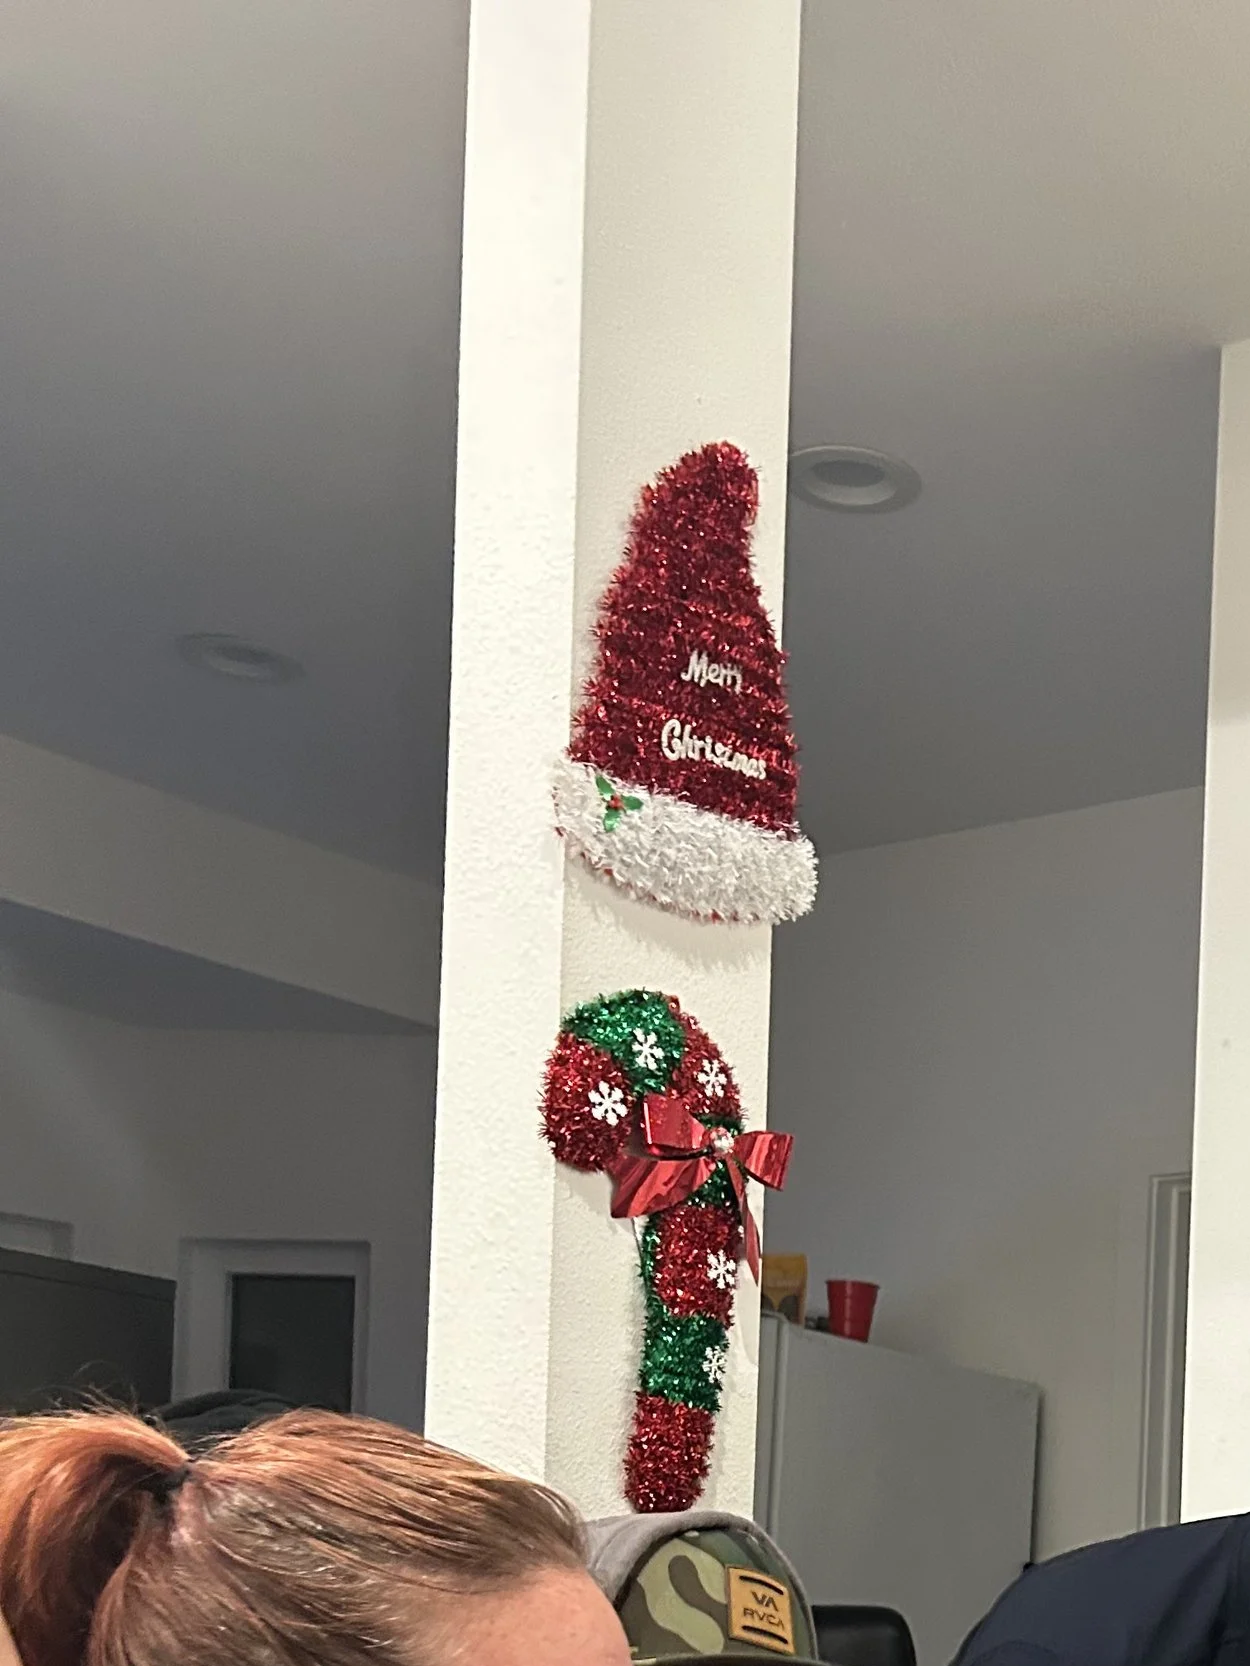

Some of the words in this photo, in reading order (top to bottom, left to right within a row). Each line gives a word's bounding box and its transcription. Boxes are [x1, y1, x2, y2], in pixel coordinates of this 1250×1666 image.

[680, 649, 743, 694] Merry
[661, 718, 767, 780] Christmas
[743, 1607, 785, 1630] RVCA
